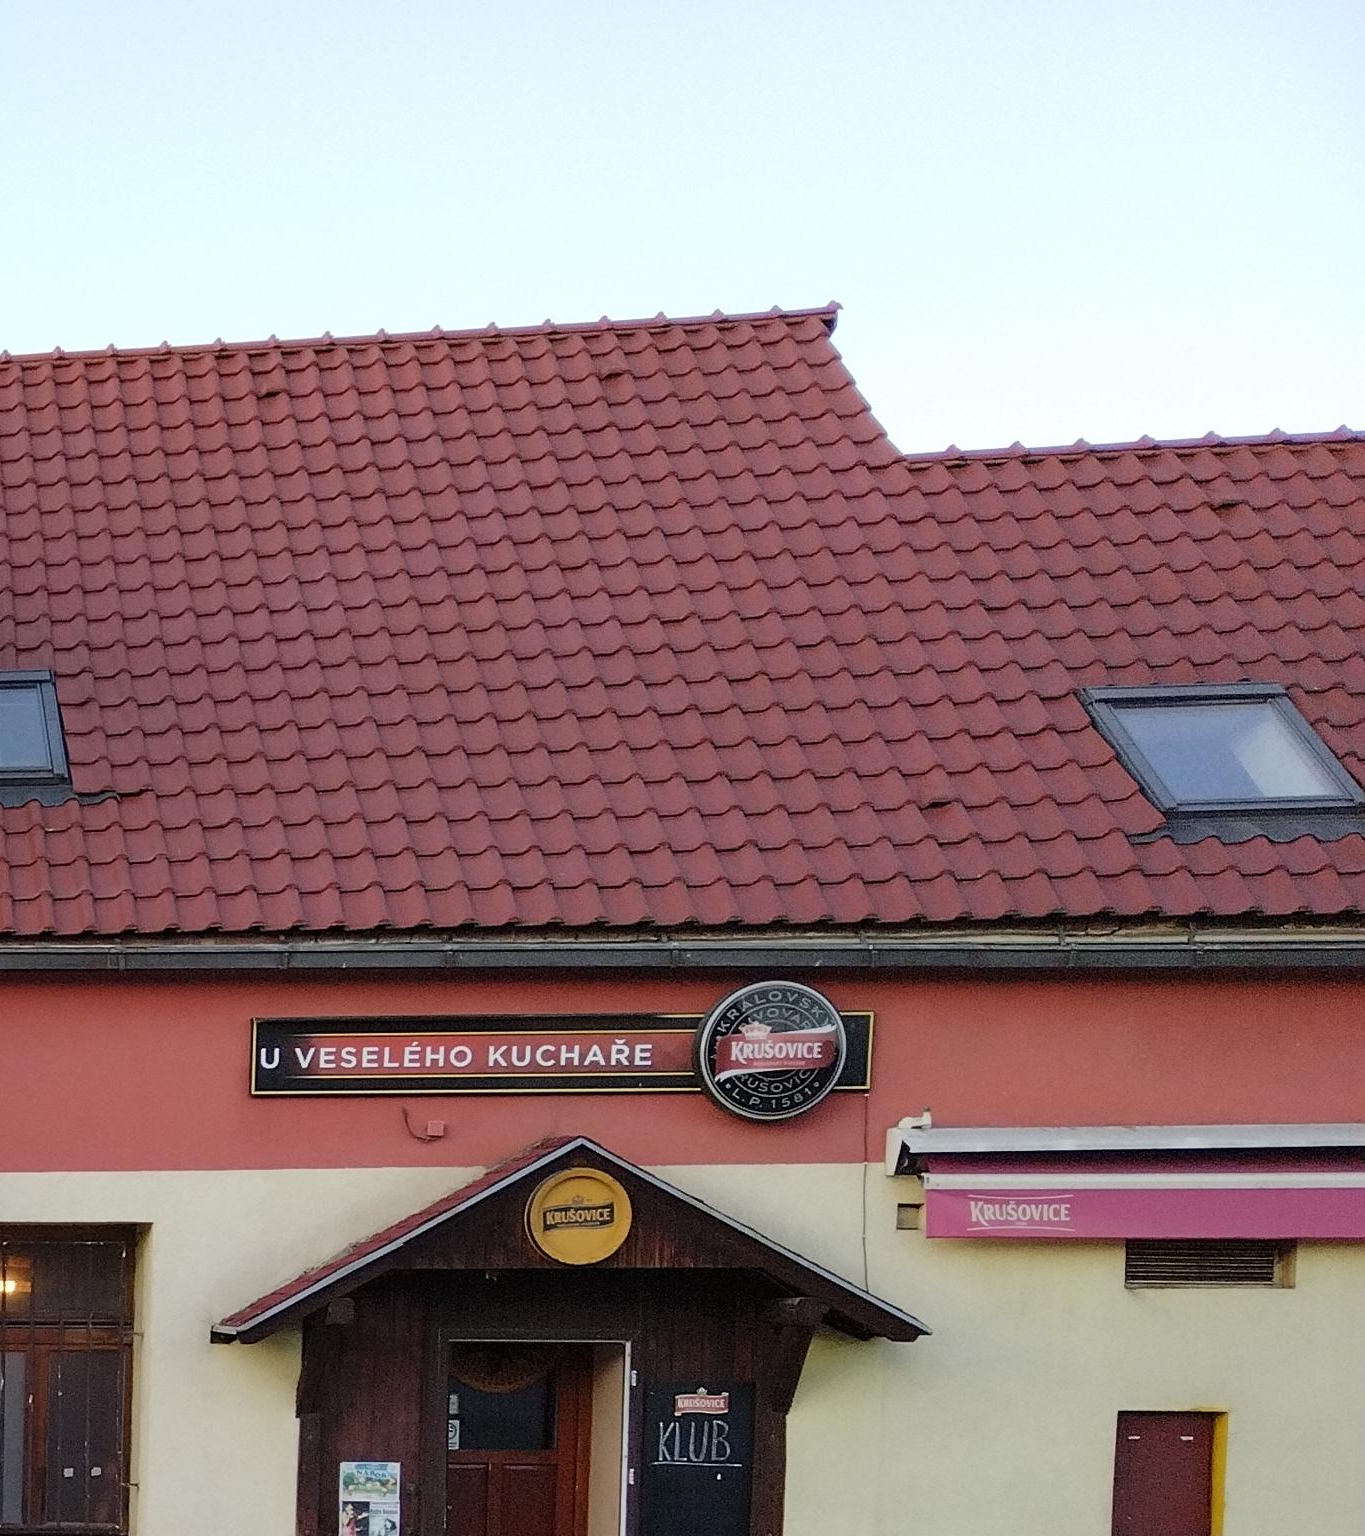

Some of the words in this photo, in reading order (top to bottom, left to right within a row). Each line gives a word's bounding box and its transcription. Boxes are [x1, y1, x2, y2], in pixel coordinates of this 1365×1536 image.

[260, 1047, 280, 1068] U
[294, 1041, 473, 1068] VESELÉHO
[488, 1039, 653, 1067] KUCHAŘE
[730, 1040, 823, 1064] KRUŠOVICE
[770, 1087, 813, 1109] 1581
[546, 1208, 612, 1225] KRUŠOVICE
[970, 1200, 1071, 1226] KRUŠOVICE
[658, 1420, 731, 1462] KLUB
